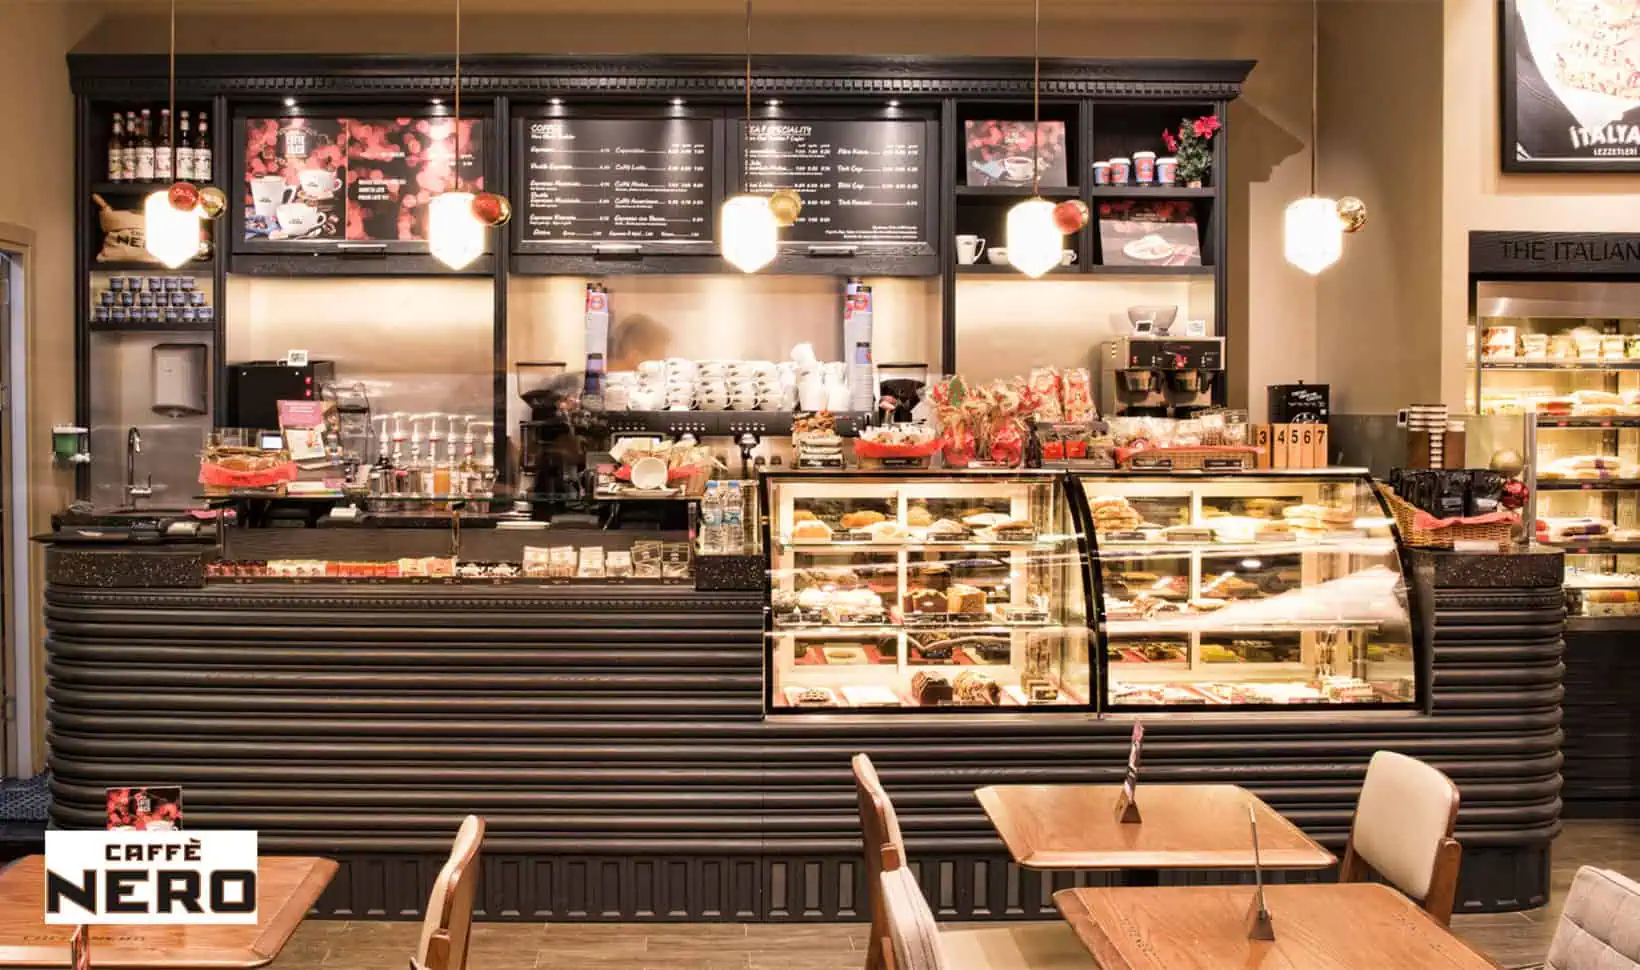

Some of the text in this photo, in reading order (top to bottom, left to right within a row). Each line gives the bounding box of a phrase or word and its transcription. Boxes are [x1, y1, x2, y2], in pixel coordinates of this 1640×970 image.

[1501, 240, 1640, 262] THE ITALIAN
[1259, 429, 1325, 445] 3 4 5 6 7
